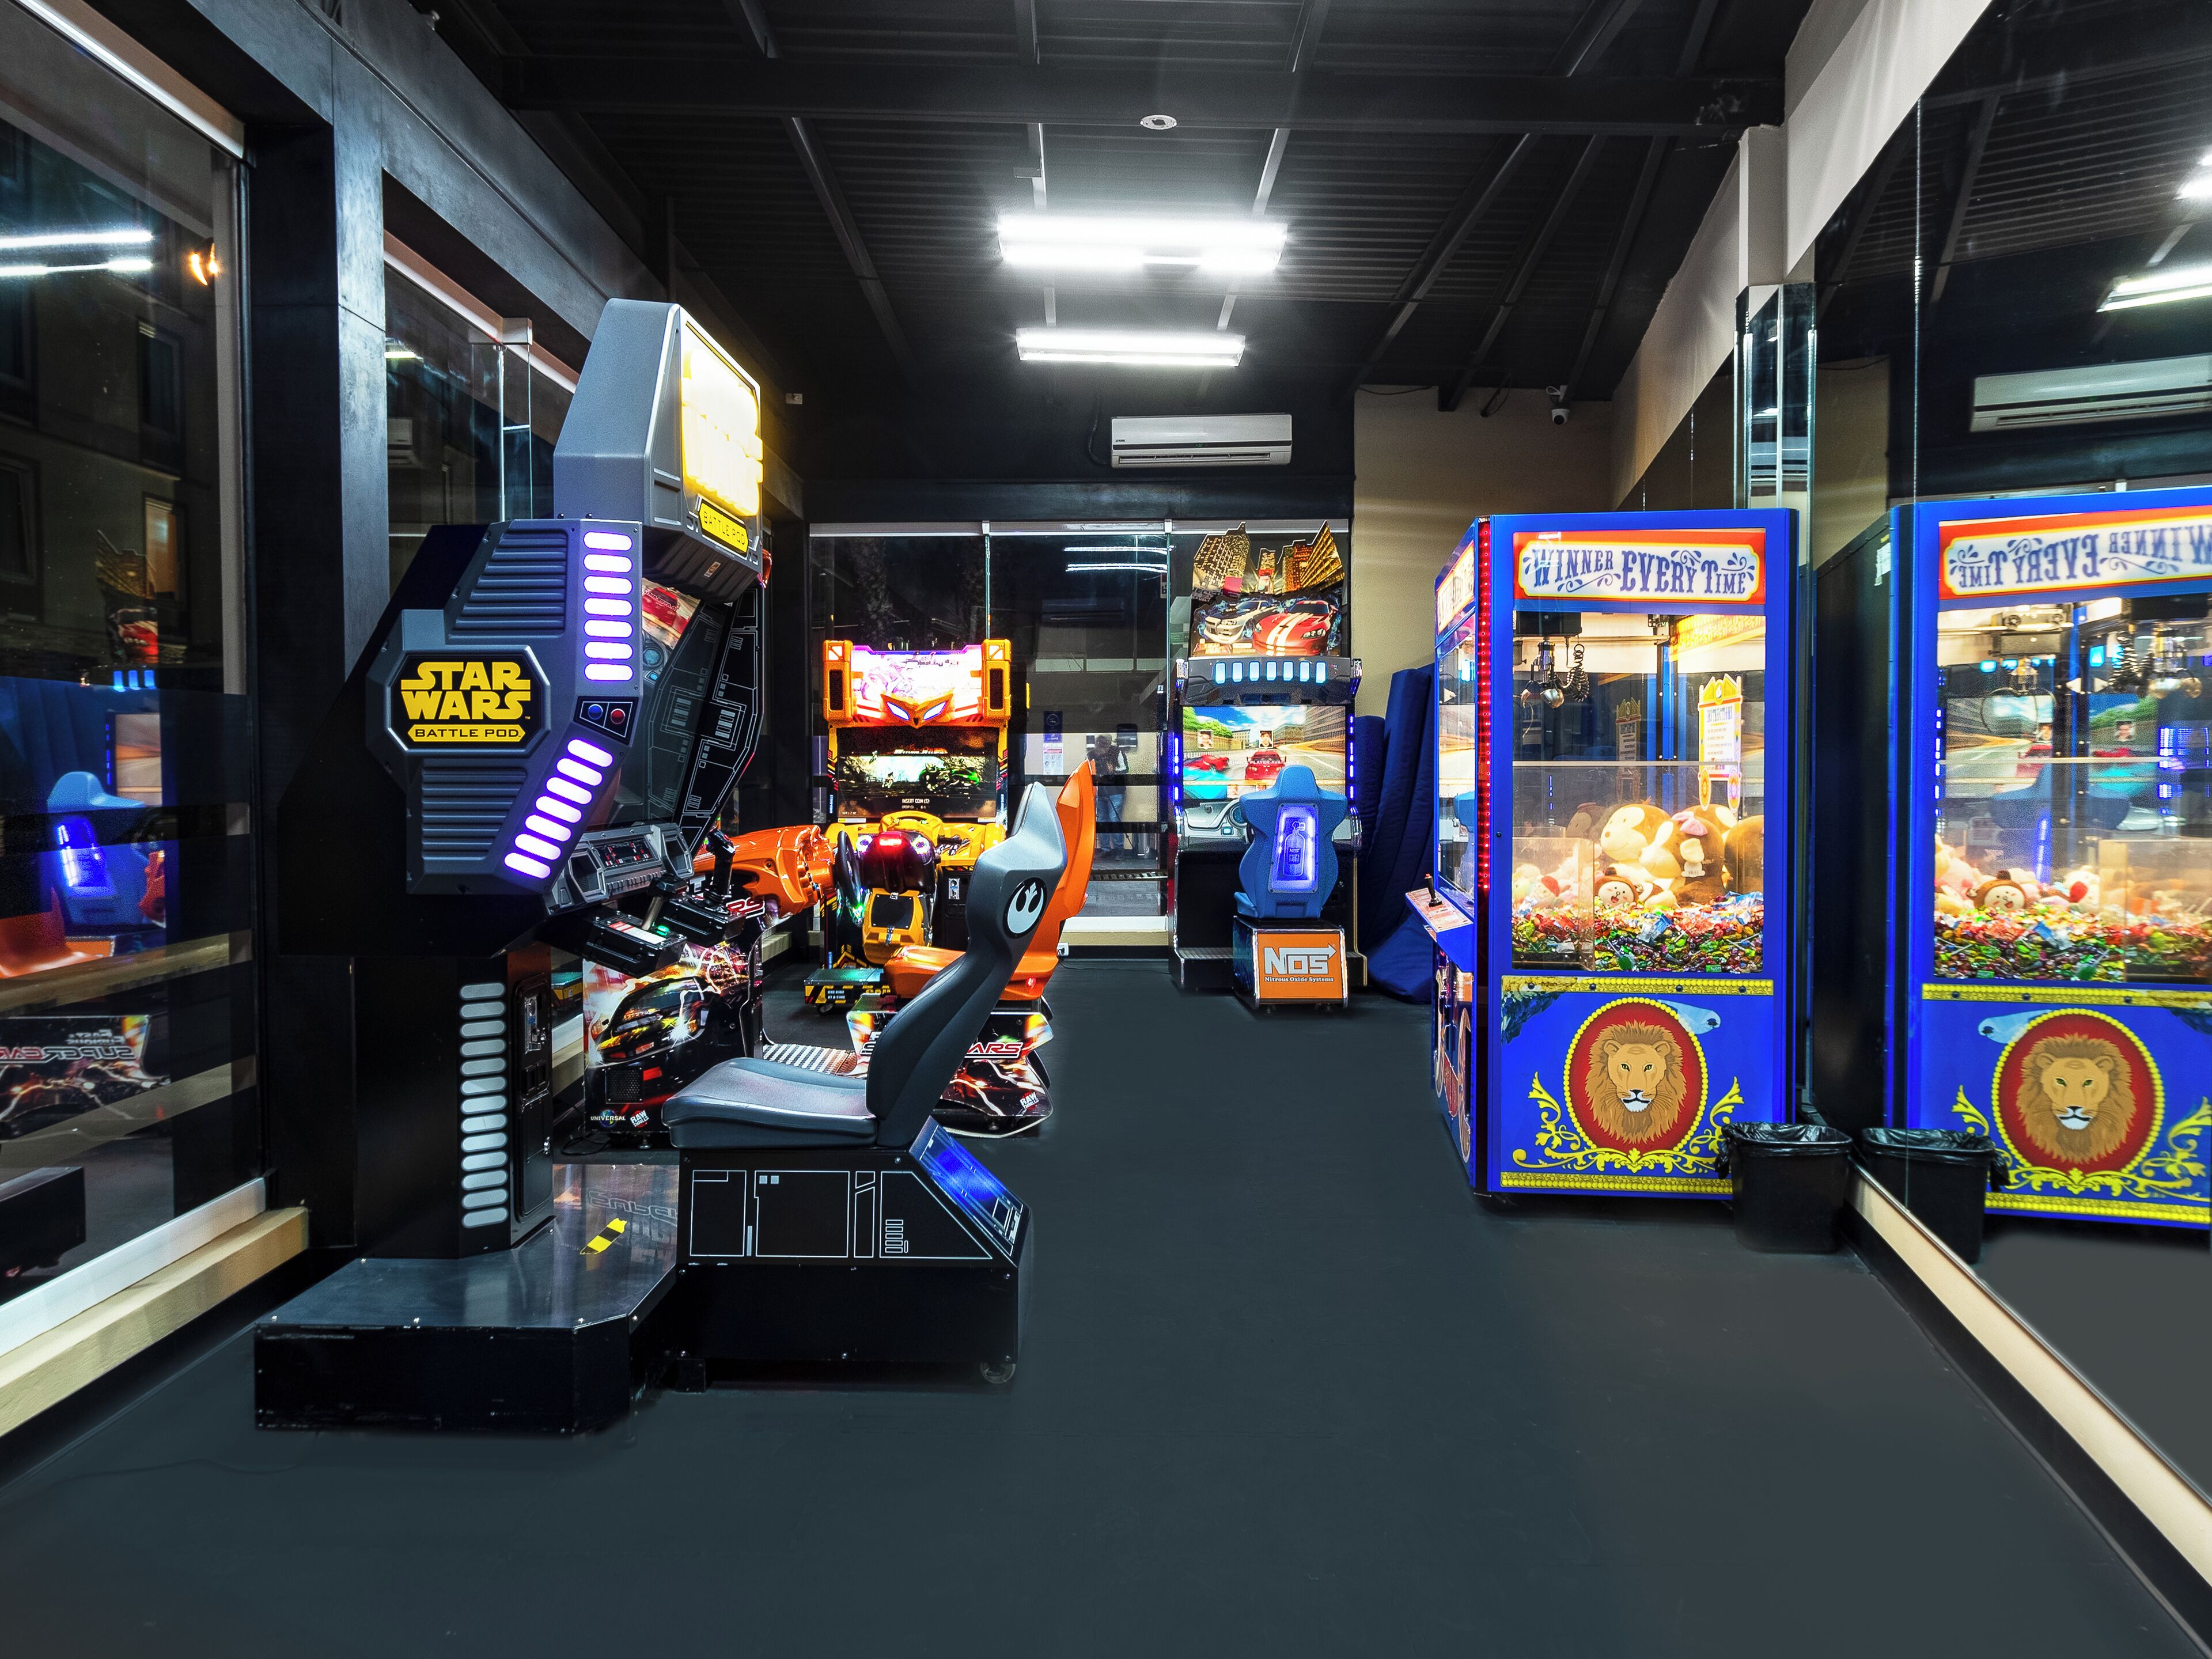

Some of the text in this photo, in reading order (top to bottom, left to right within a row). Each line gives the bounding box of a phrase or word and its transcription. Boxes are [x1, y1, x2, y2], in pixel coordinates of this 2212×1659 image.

[703, 511, 745, 545] BATTLE POD
[1531, 548, 1747, 594] WINNER EVERY TIME
[401, 662, 531, 690] STAR
[401, 691, 531, 719] WARS
[415, 729, 520, 737] BATTLE POD
[1264, 944, 1336, 975] NOS
[1020, 1092, 1037, 1107] RAW
[630, 1111, 647, 1124] RAW
